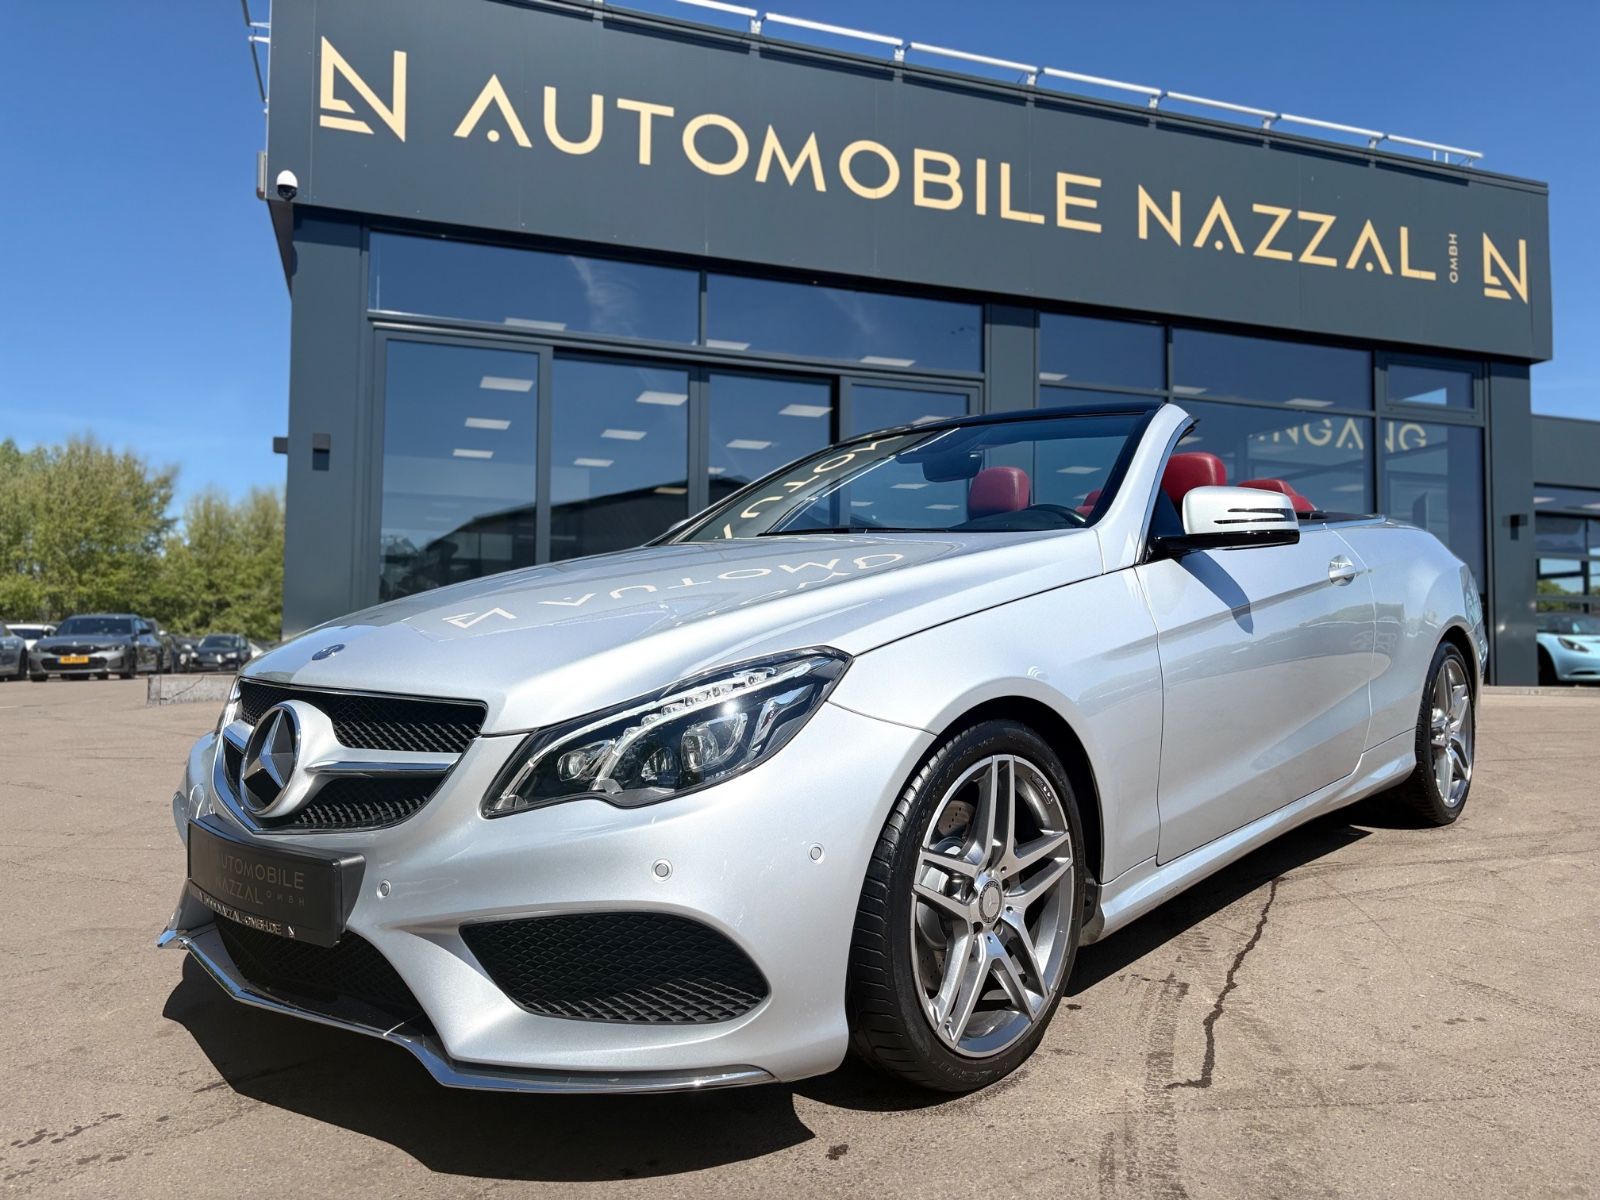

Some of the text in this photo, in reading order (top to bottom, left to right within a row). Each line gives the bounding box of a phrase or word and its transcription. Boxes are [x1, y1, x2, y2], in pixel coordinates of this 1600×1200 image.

[453, 74, 1102, 234] AUTOMOBILE
[1138, 184, 1437, 281] NAZZAL
[217, 853, 305, 890] UTOMOBILE
